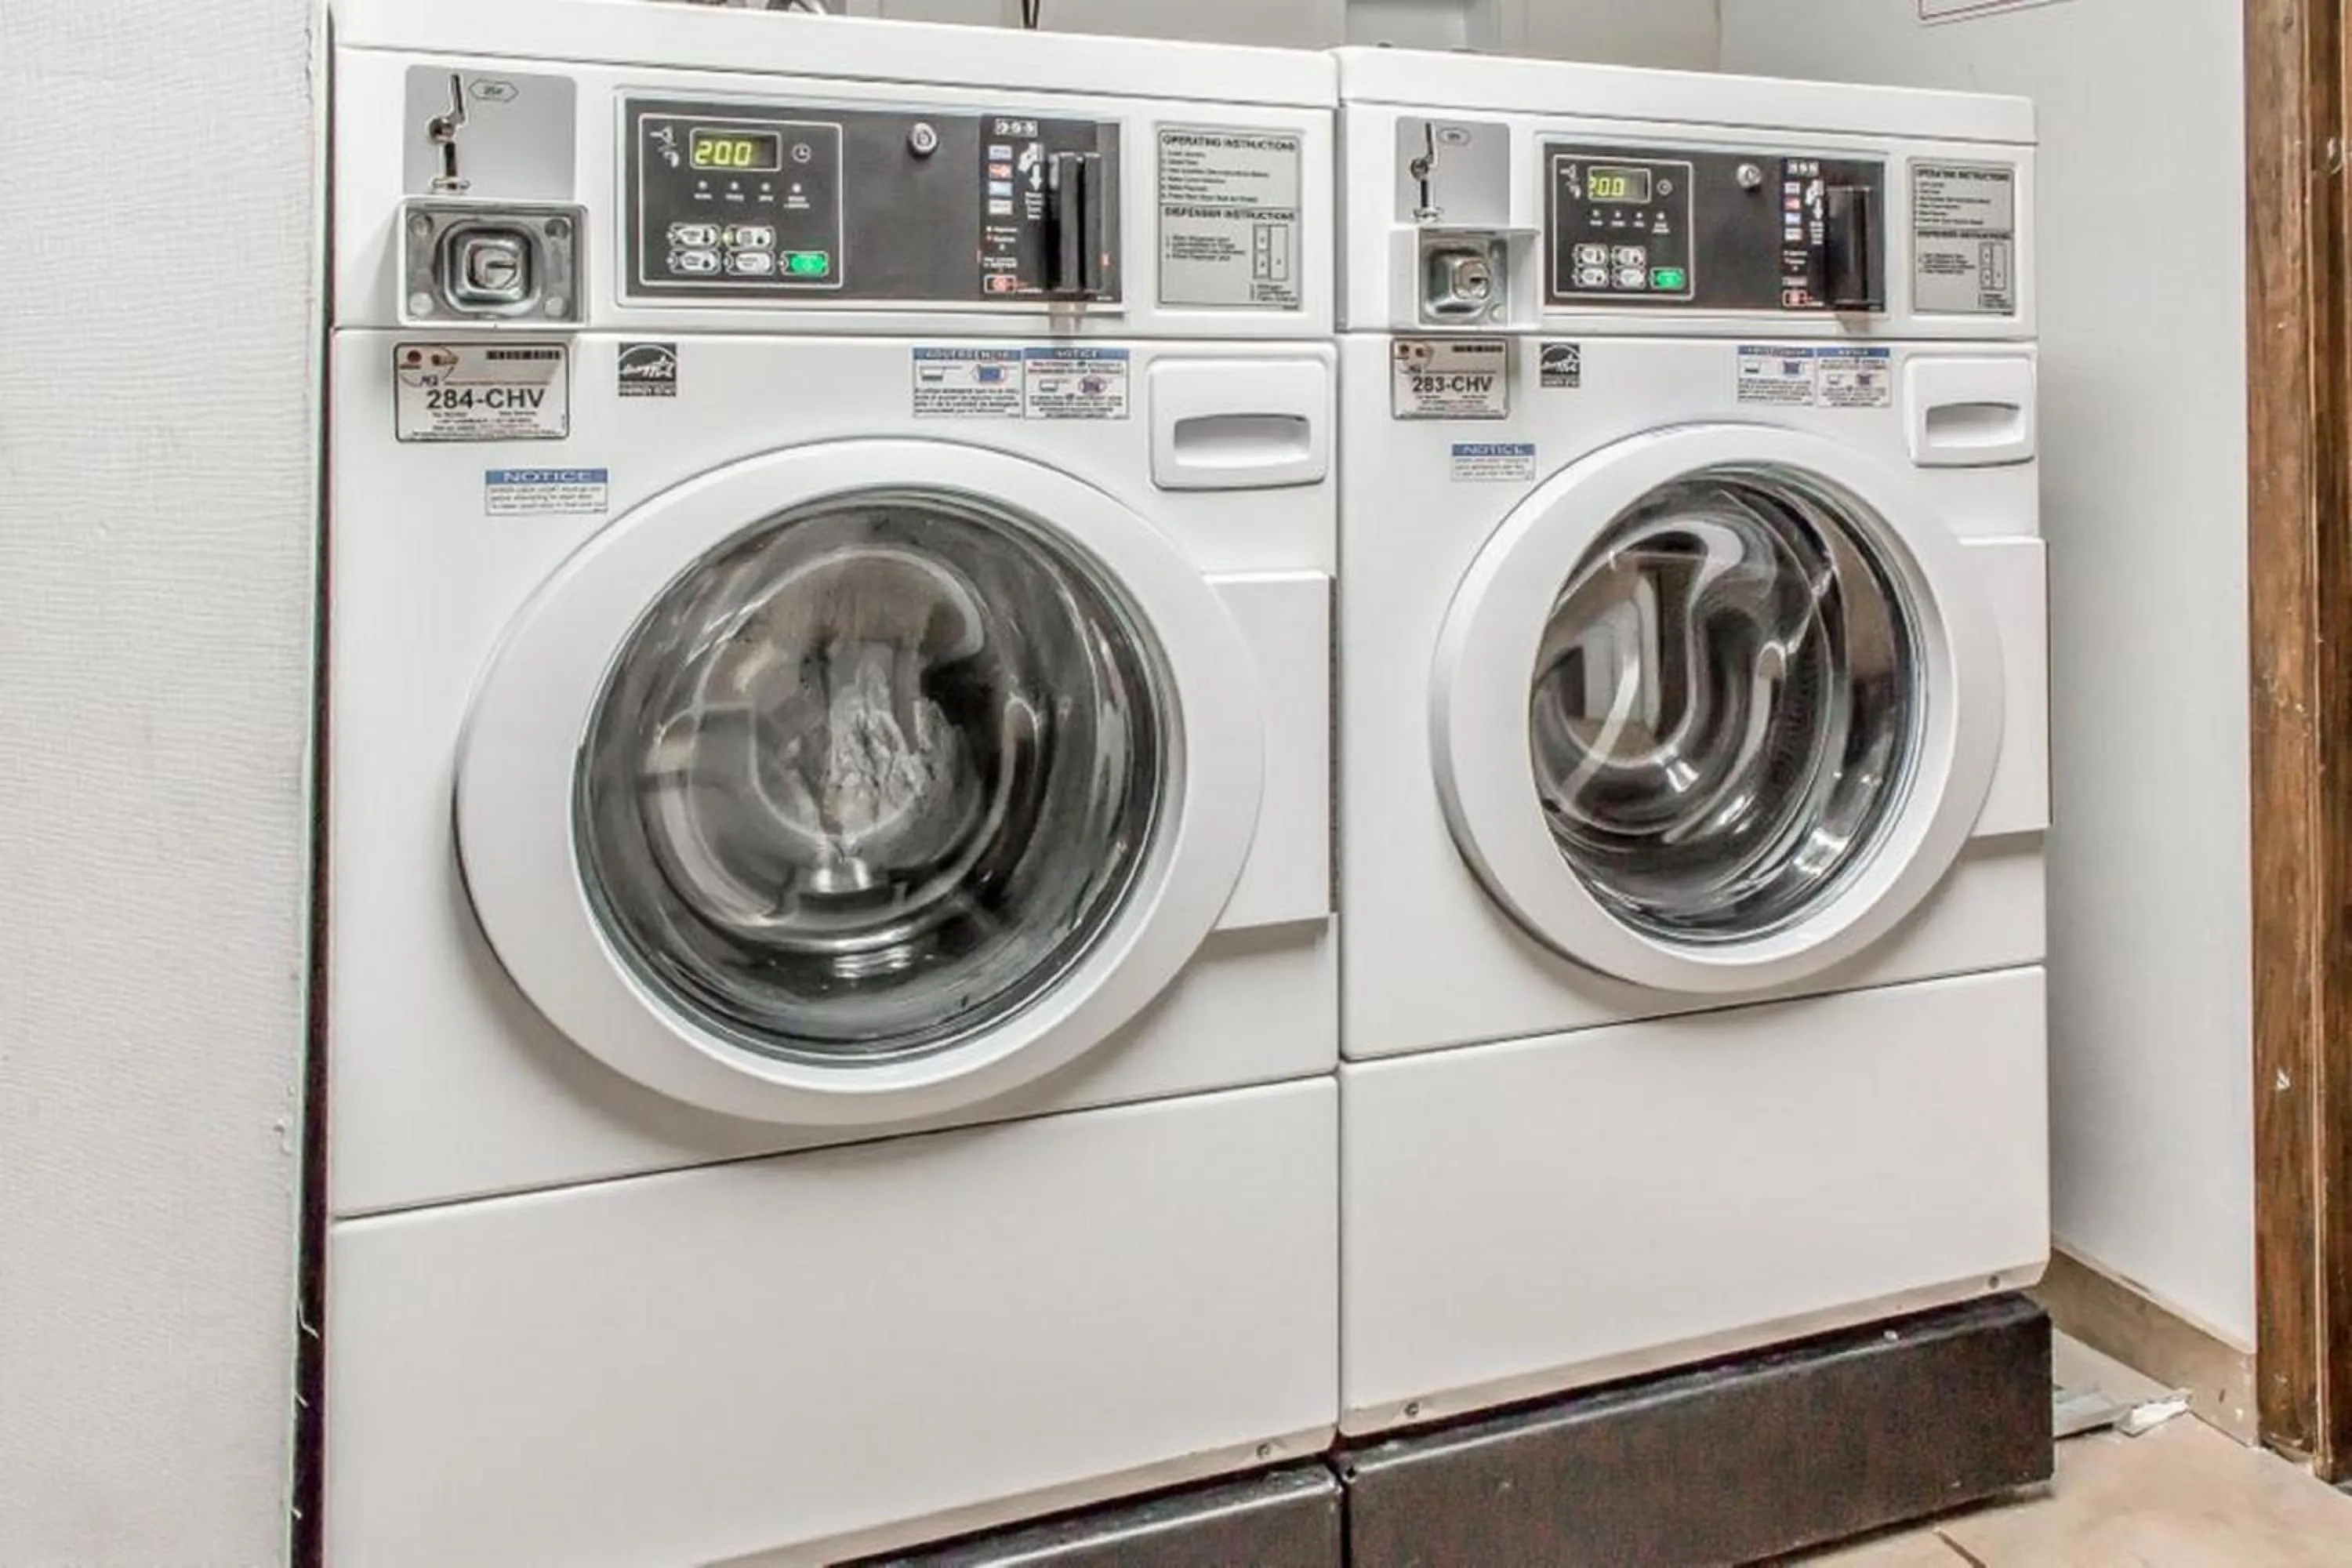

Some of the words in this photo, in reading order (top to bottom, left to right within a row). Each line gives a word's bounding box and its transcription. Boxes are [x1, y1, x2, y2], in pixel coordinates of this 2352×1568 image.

[1163, 135, 1221, 147] OPERATING
[1224, 139, 1295, 151] INSTRUCTIONS
[695, 140, 753, 166] 200
[1412, 376, 1494, 393] 283-CHV
[426, 388, 545, 409] 284-CHV
[503, 471, 593, 481] NOTICE
